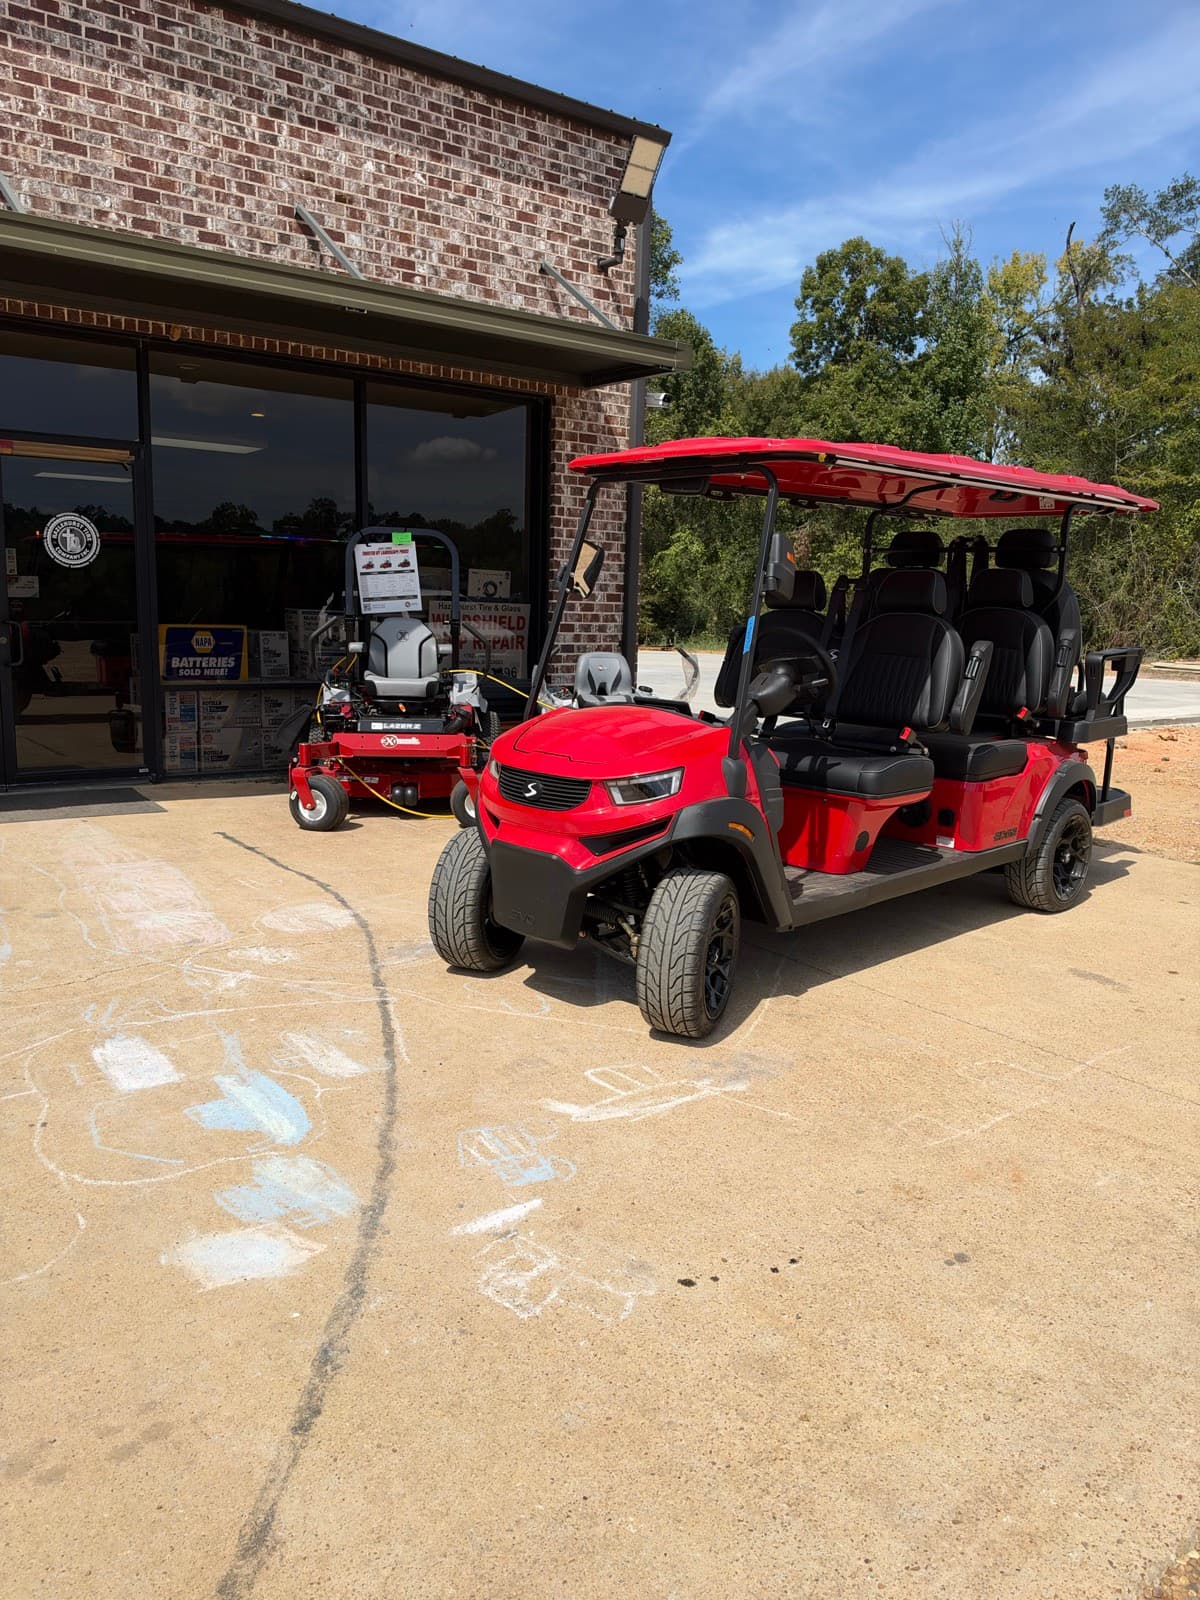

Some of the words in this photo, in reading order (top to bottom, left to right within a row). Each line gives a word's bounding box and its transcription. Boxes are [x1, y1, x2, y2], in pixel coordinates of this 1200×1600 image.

[479, 603, 492, 611] Tire
[493, 604, 499, 612] &
[501, 604, 521, 612] Glass
[195, 637, 212, 647] NAPA
[171, 656, 236, 668] BATTERIES
[178, 668, 201, 676] SOLD
[203, 668, 229, 676] HERE!
[524, 782, 537, 797] S
